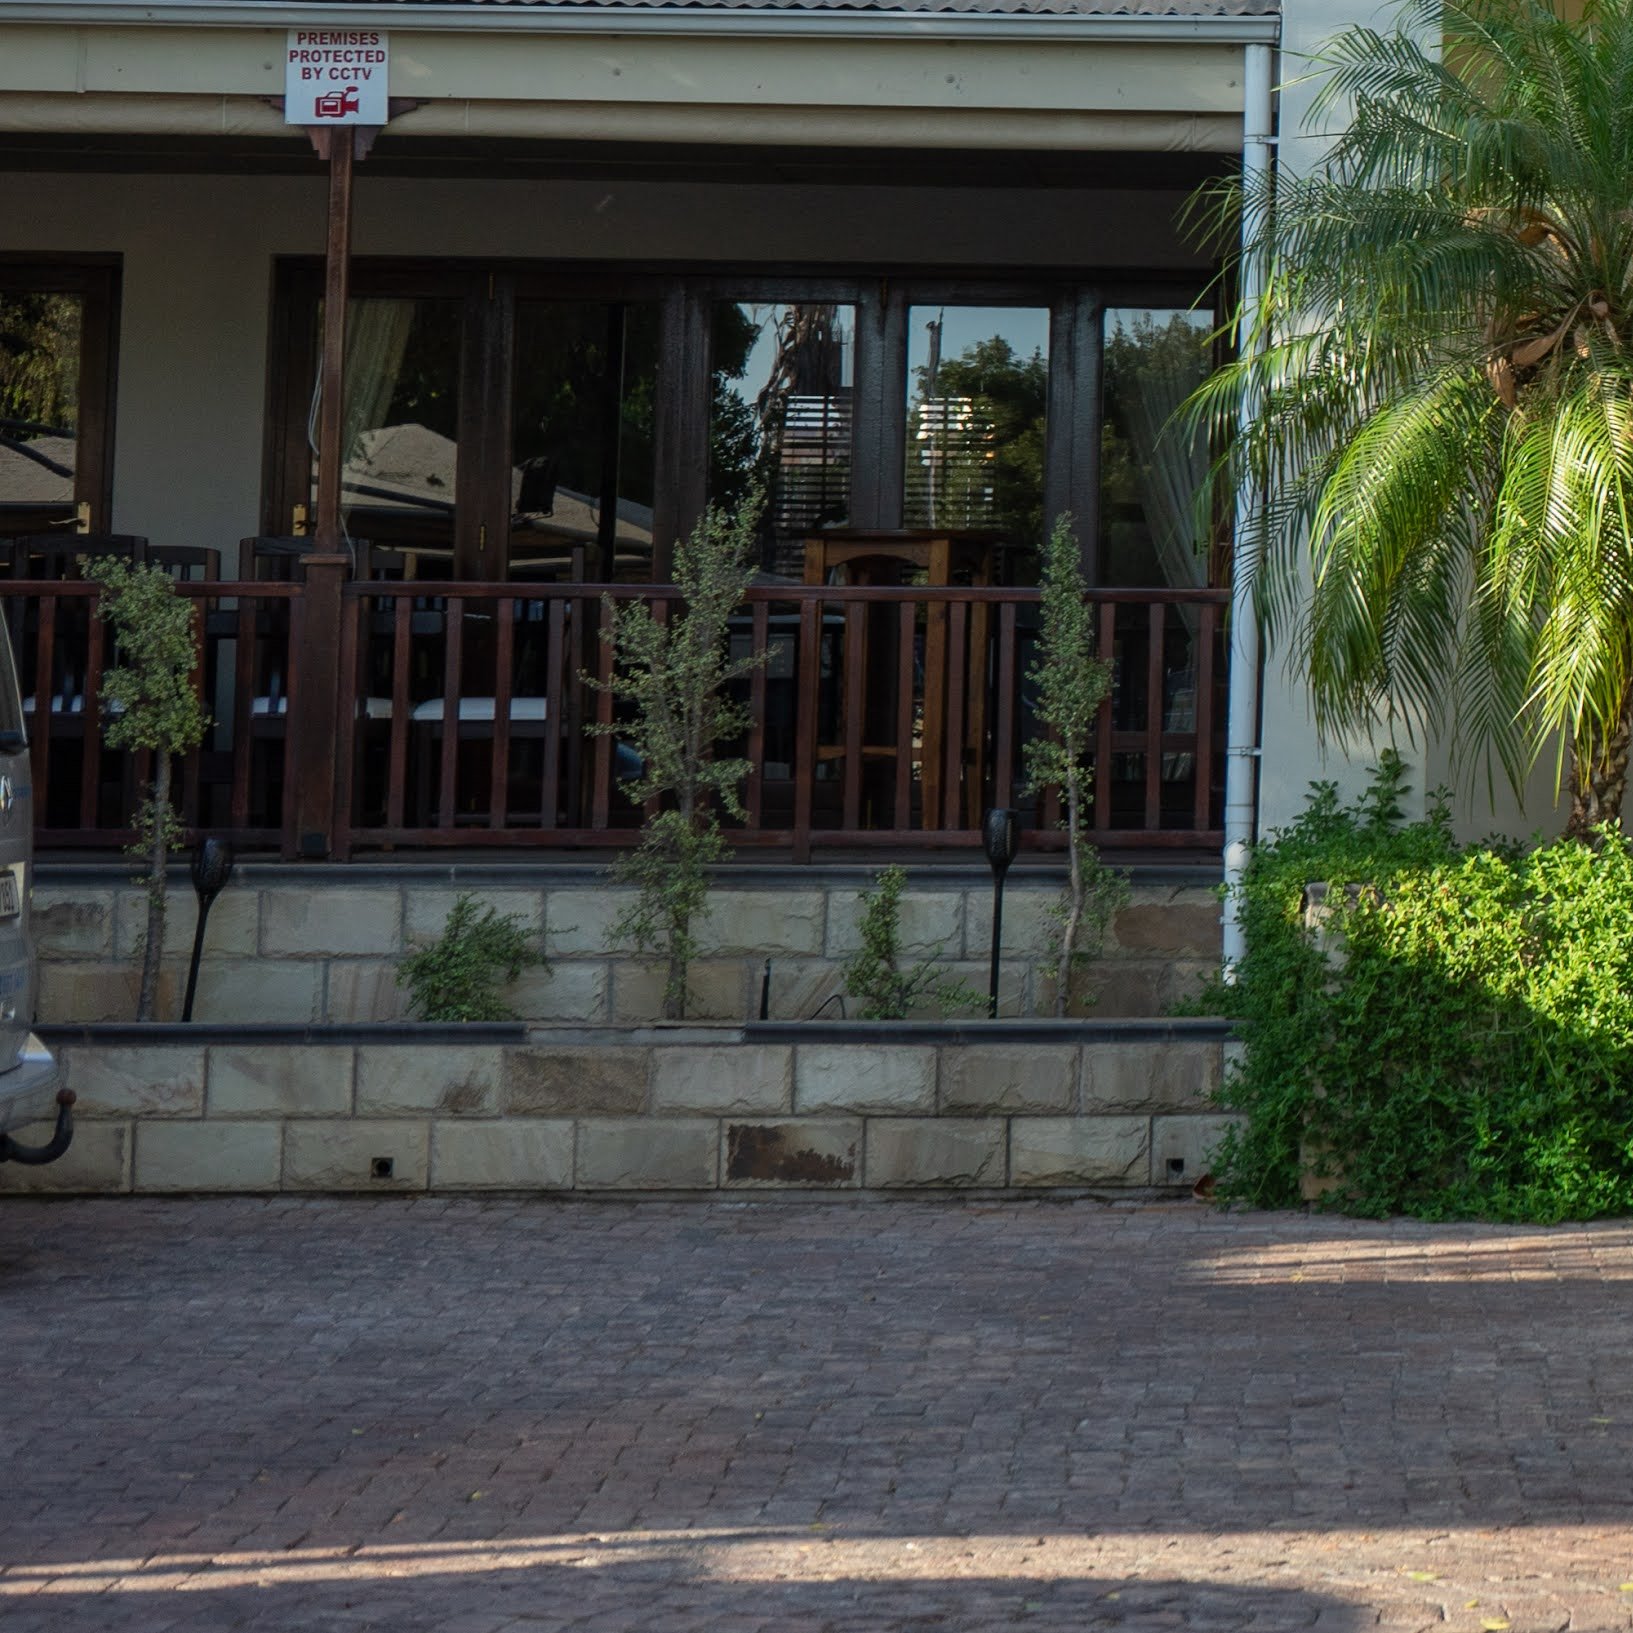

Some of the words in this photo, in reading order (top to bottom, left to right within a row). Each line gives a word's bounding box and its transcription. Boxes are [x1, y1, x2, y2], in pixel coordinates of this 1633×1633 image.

[297, 32, 380, 46] PREMISES
[289, 50, 386, 63] PROTECTED
[301, 67, 323, 80] BY
[329, 67, 372, 81] CCTV
